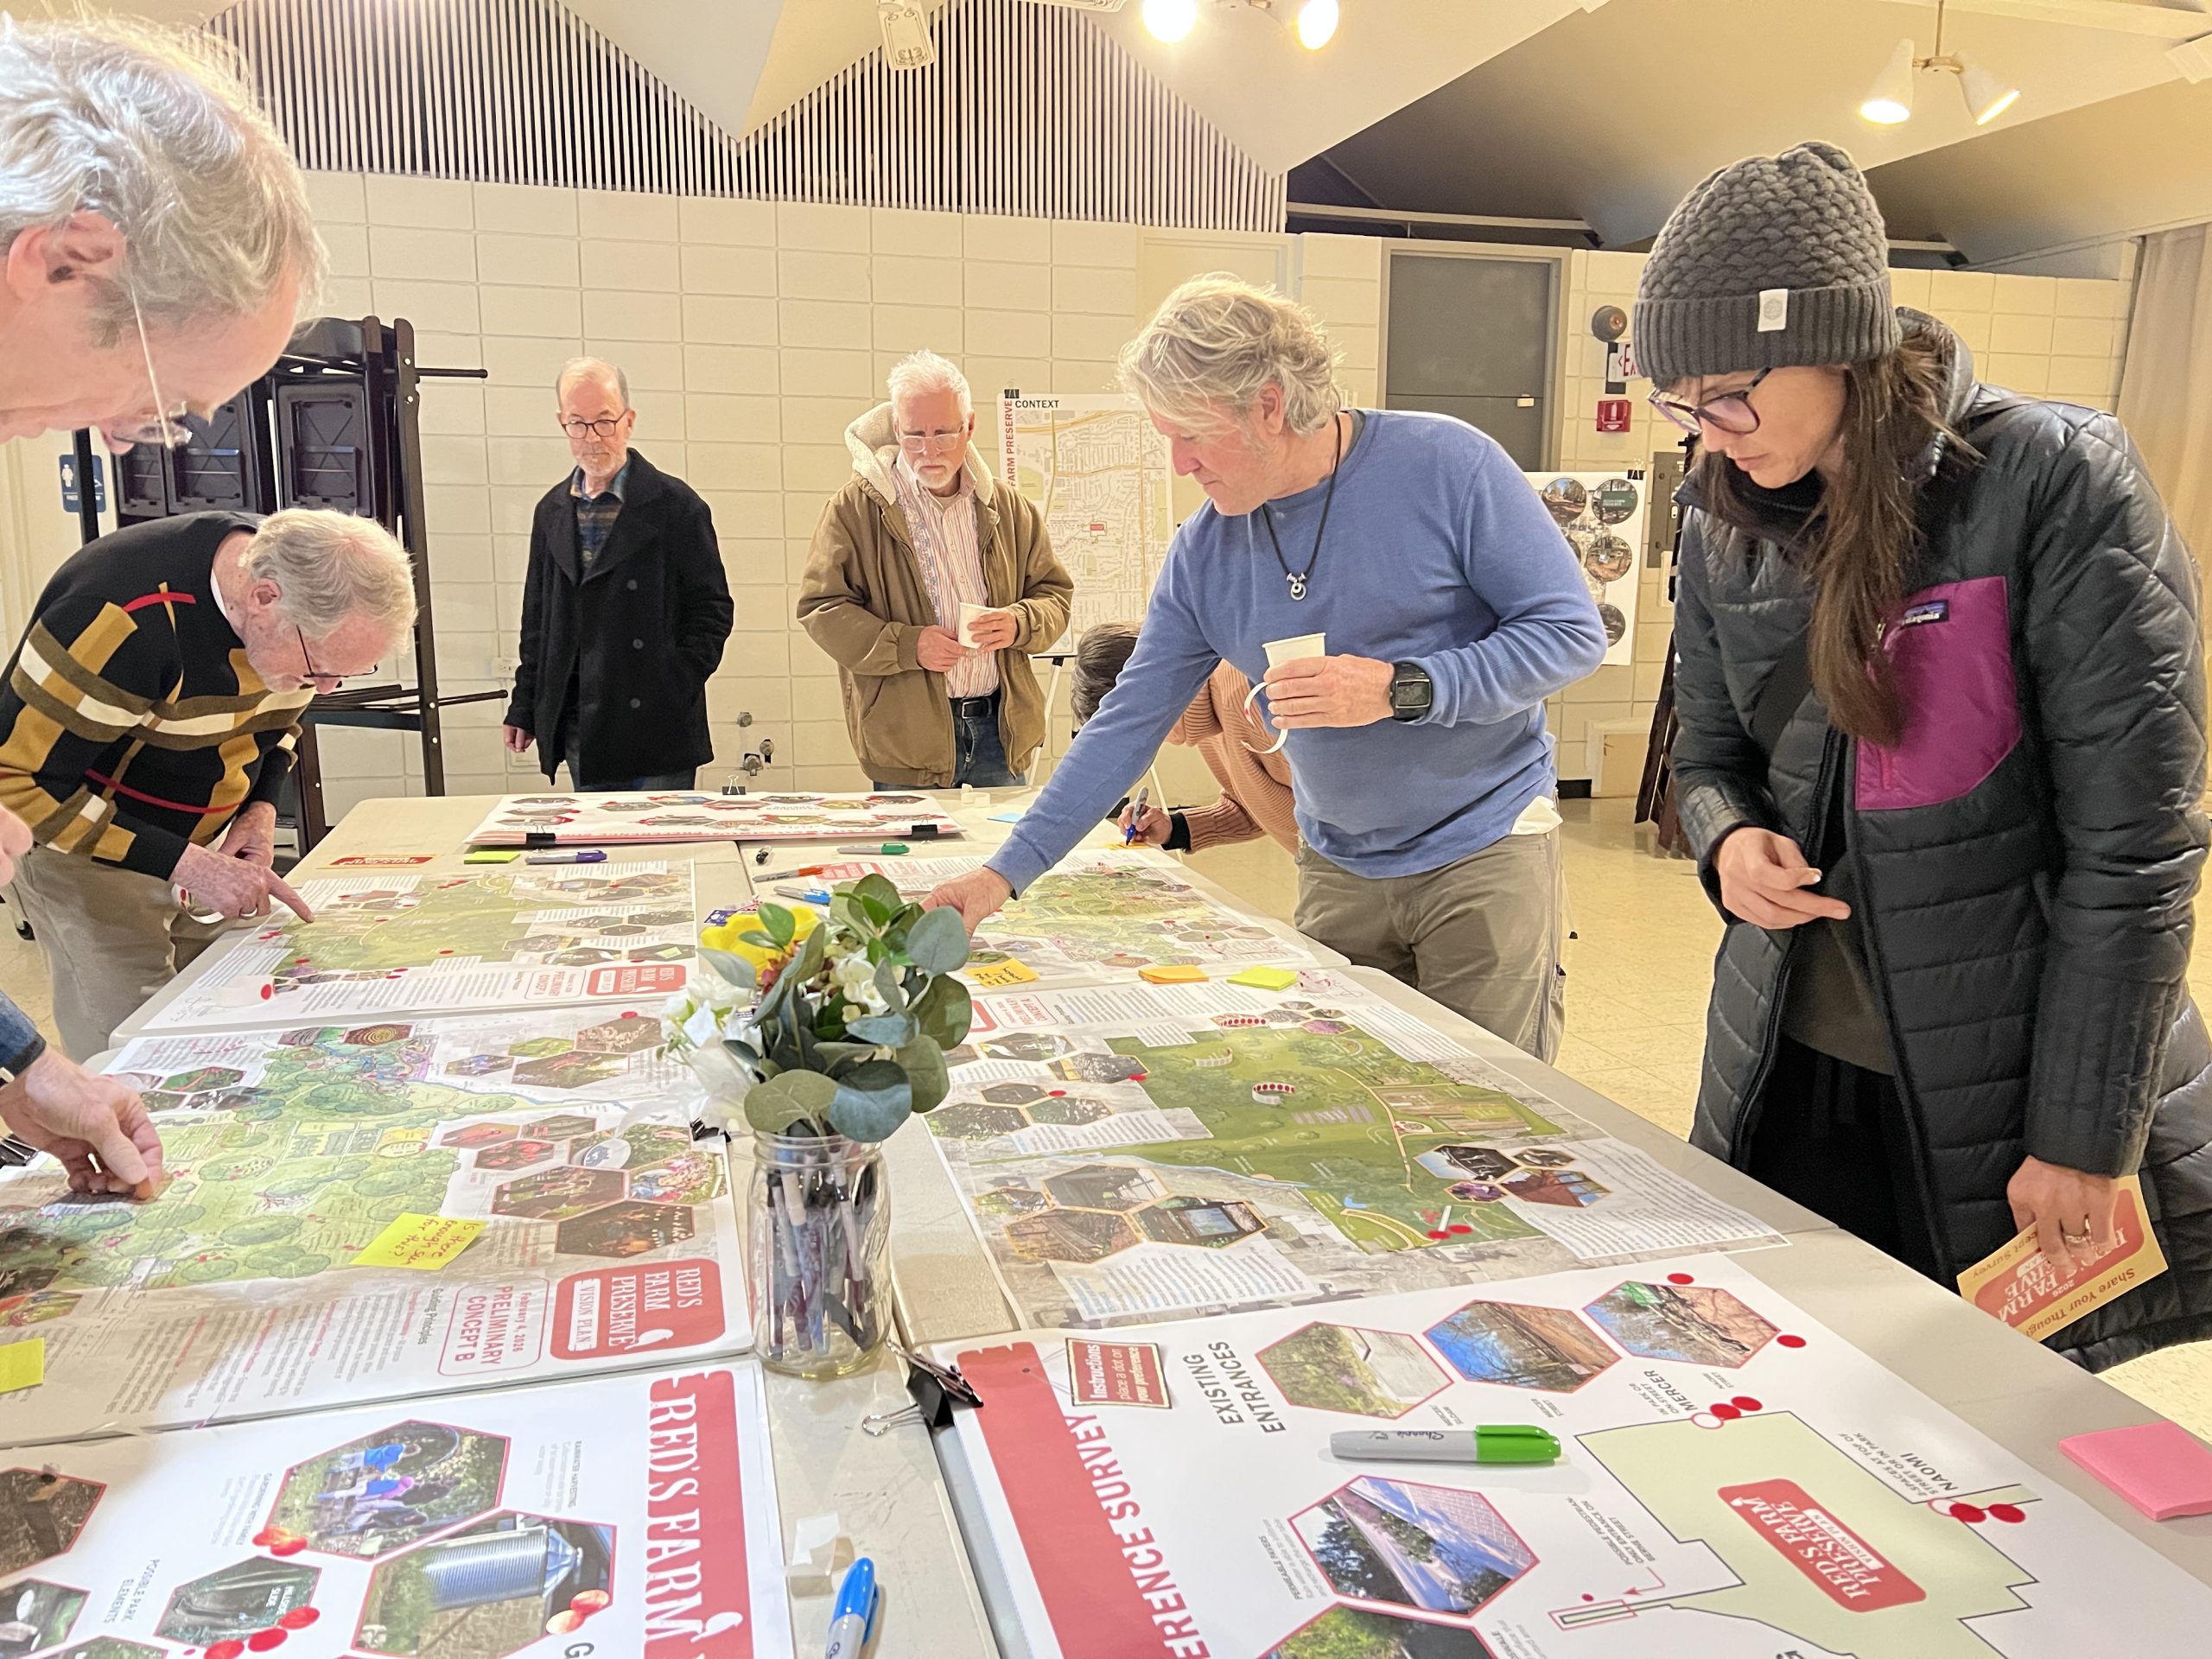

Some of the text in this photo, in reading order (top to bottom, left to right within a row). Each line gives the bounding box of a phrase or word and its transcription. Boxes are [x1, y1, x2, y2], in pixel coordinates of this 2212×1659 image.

[1015, 400, 1059, 409] CONTEXT
[1004, 400, 1016, 486] FARM PRESERVE
[388, 1218, 439, 1257] for this?
[422, 1219, 459, 1249] enough
[432, 1235, 467, 1258] there
[2014, 1230, 2038, 1253] cept
[1973, 1249, 2012, 1280] Survey
[645, 1270, 671, 1313] FARM
[676, 1267, 703, 1308] RED'S
[2098, 1268, 2136, 1294] Share
[515, 1292, 532, 1324] February
[608, 1274, 637, 1348] PRESERVE
[1999, 1273, 2060, 1322] FARM
[2069, 1292, 2097, 1312] Your
[417, 1313, 438, 1344] Principles
[454, 1295, 488, 1362] CONCEPT B
[480, 1286, 514, 1364] PRELIMINARY
[576, 1286, 595, 1346] VISION PLAN
[512, 1334, 526, 1352] 2026
[1115, 1348, 1122, 1359] on
[1085, 1343, 1109, 1399] Instructions
[1116, 1359, 1127, 1372] dot
[1128, 1346, 1154, 1403] your preference
[1118, 1379, 1131, 1402] place
[1183, 1354, 1245, 1425] EXISTING
[1208, 1341, 1287, 1433] ENTRANCES
[1640, 1383, 1681, 1414] ON-STREET
[1640, 1392, 1659, 1408] PARK
[1644, 1370, 1699, 1412] MERCER
[1396, 1431, 1445, 1441] Sharpie
[1838, 1433, 1854, 1442] OF
[1853, 1433, 1878, 1450] PARK
[1853, 1443, 1872, 1457] TOP
[1065, 1414, 1141, 1521] SURVEY
[1871, 1457, 1886, 1465] AT
[1888, 1459, 1904, 1470] OR
[1901, 1452, 1959, 1491] NAOMI
[1903, 1471, 1939, 1495] STREET
[645, 1394, 702, 1642] RED'S FARM
[1580, 1501, 1644, 1563] ONLY ENTRANCE ON
[1608, 1517, 1635, 1539] STREET
[1601, 1535, 1634, 1565] POSSIBLE
[1743, 1497, 1872, 1599] RED'S FARM
[1770, 1501, 1882, 1586] PRESERVE
[1813, 1514, 1872, 1563] VISION PLAN
[104, 1578, 135, 1624] ELEMENTS
